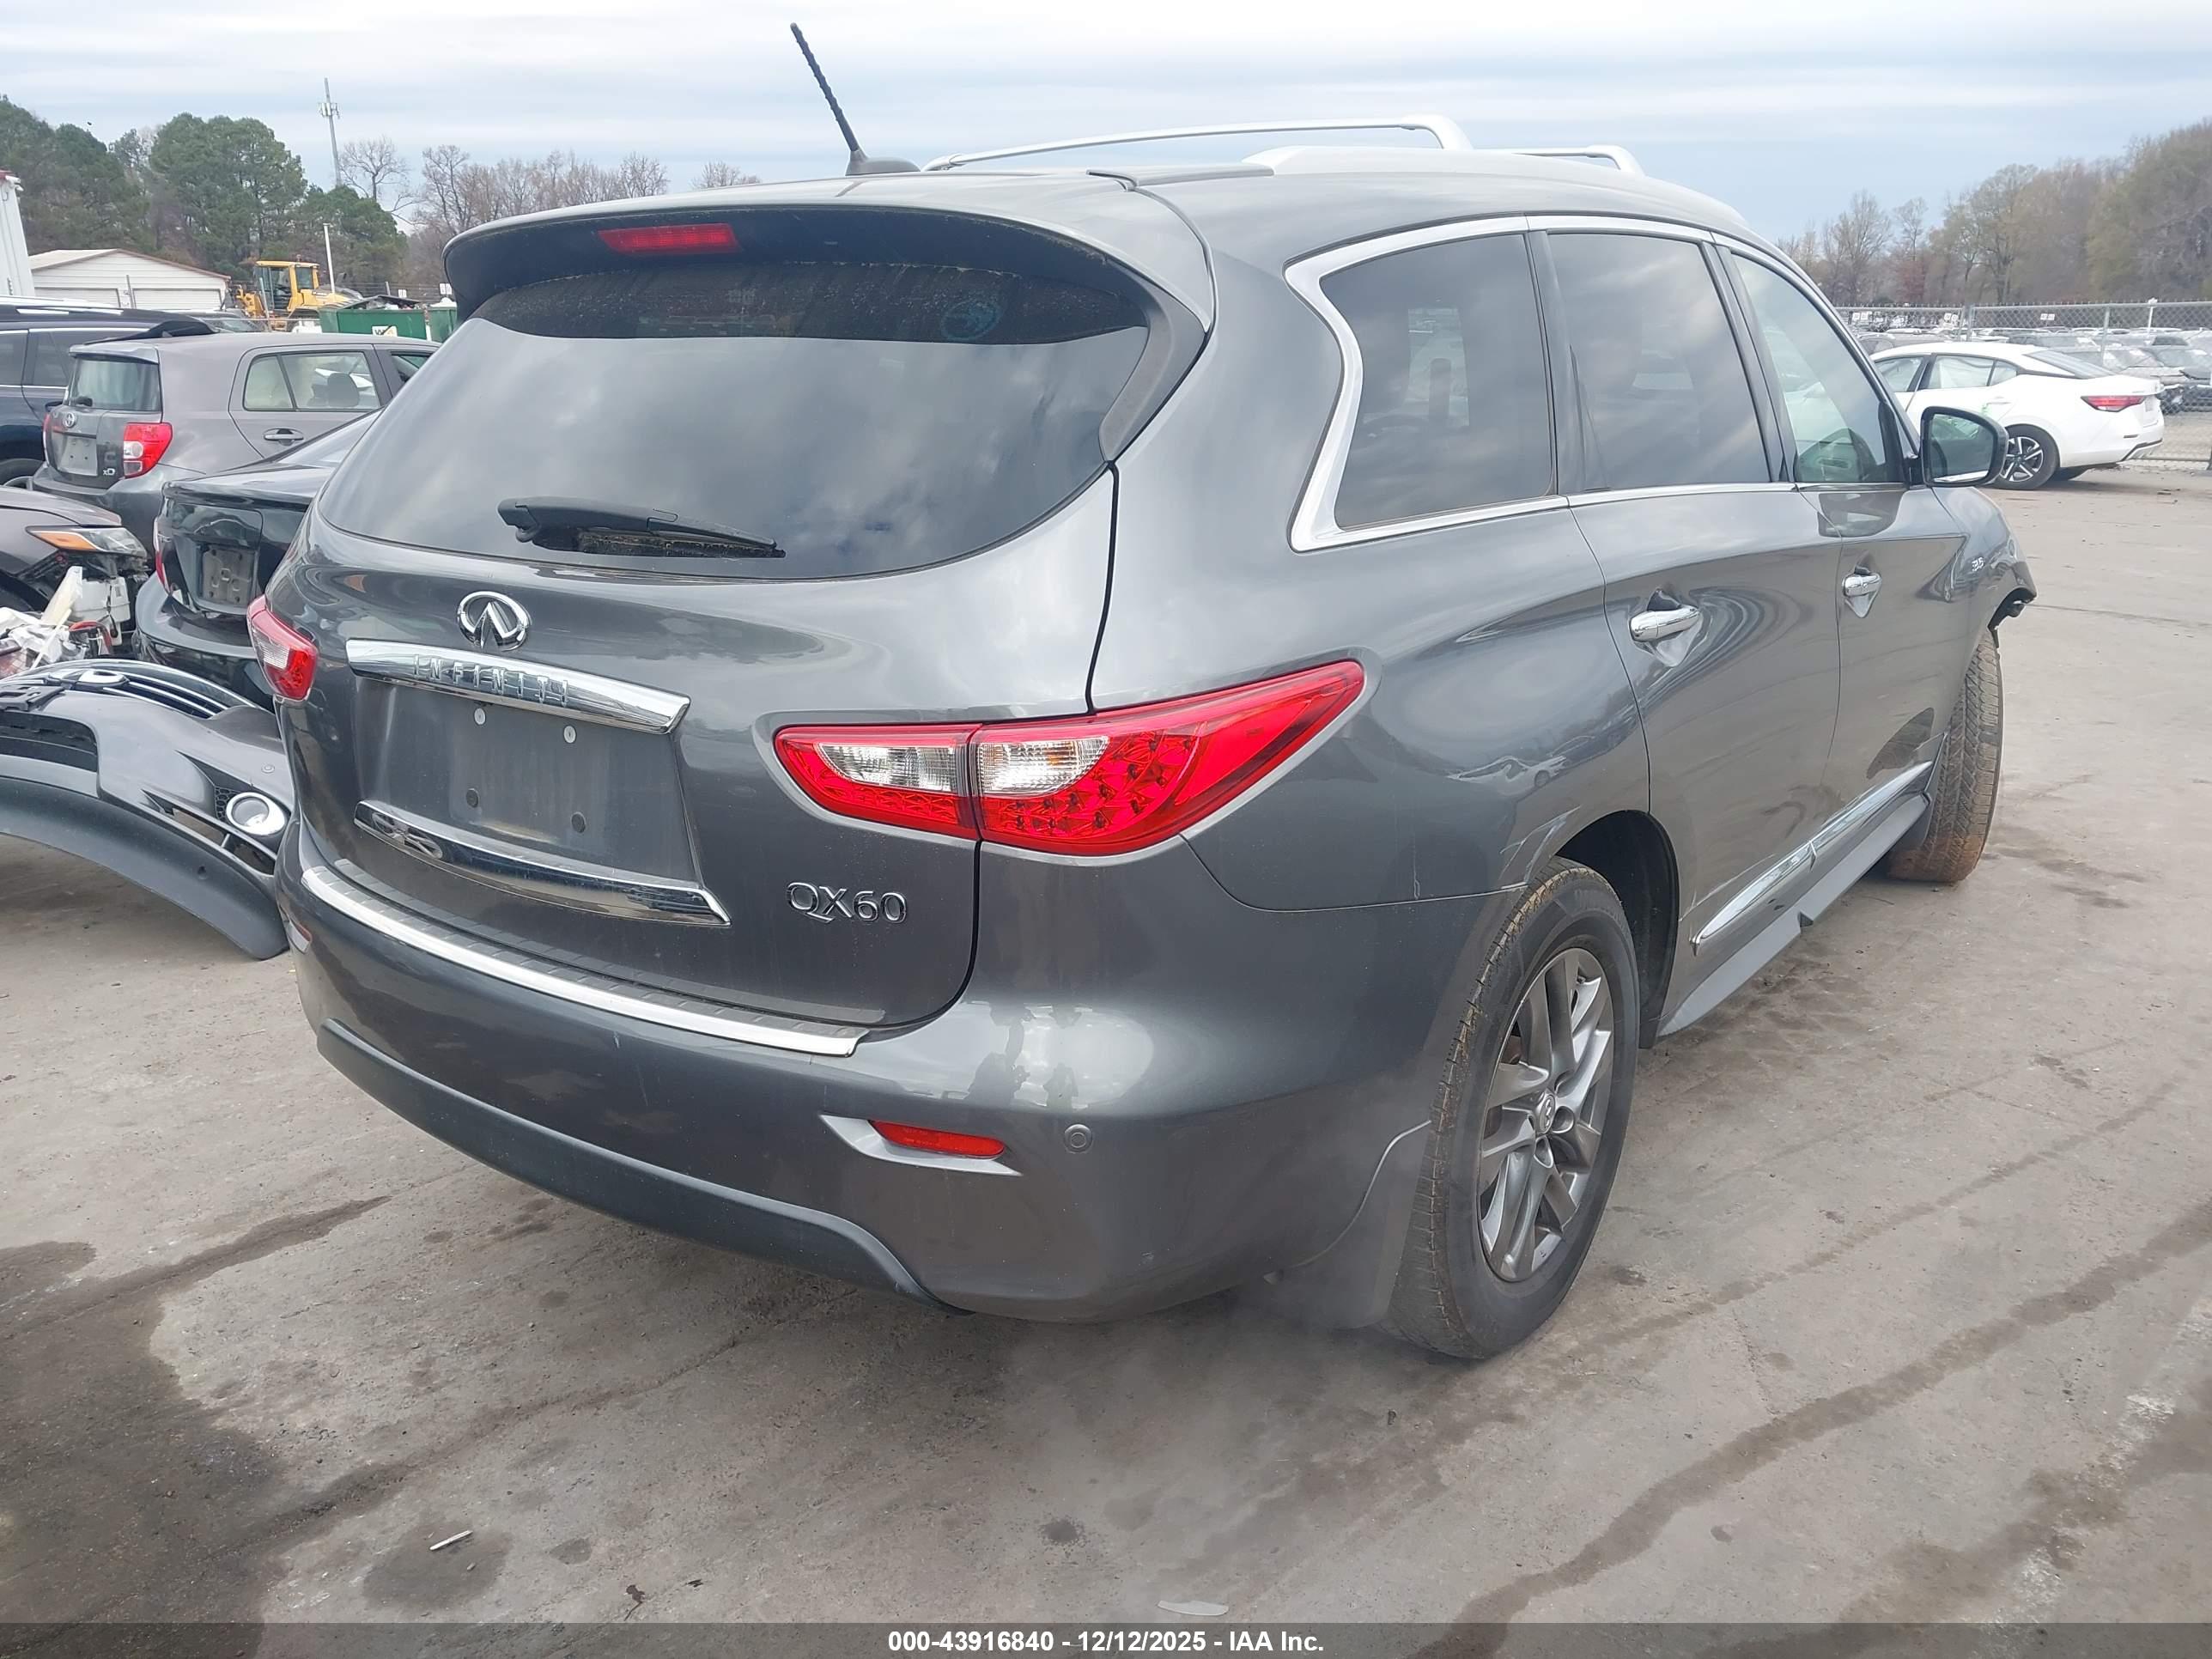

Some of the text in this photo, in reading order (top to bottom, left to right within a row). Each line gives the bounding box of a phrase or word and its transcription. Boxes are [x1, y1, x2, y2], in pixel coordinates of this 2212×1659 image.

[102, 467, 116, 477] xD
[412, 653, 568, 708] INFINITI
[785, 880, 908, 924] QX60
